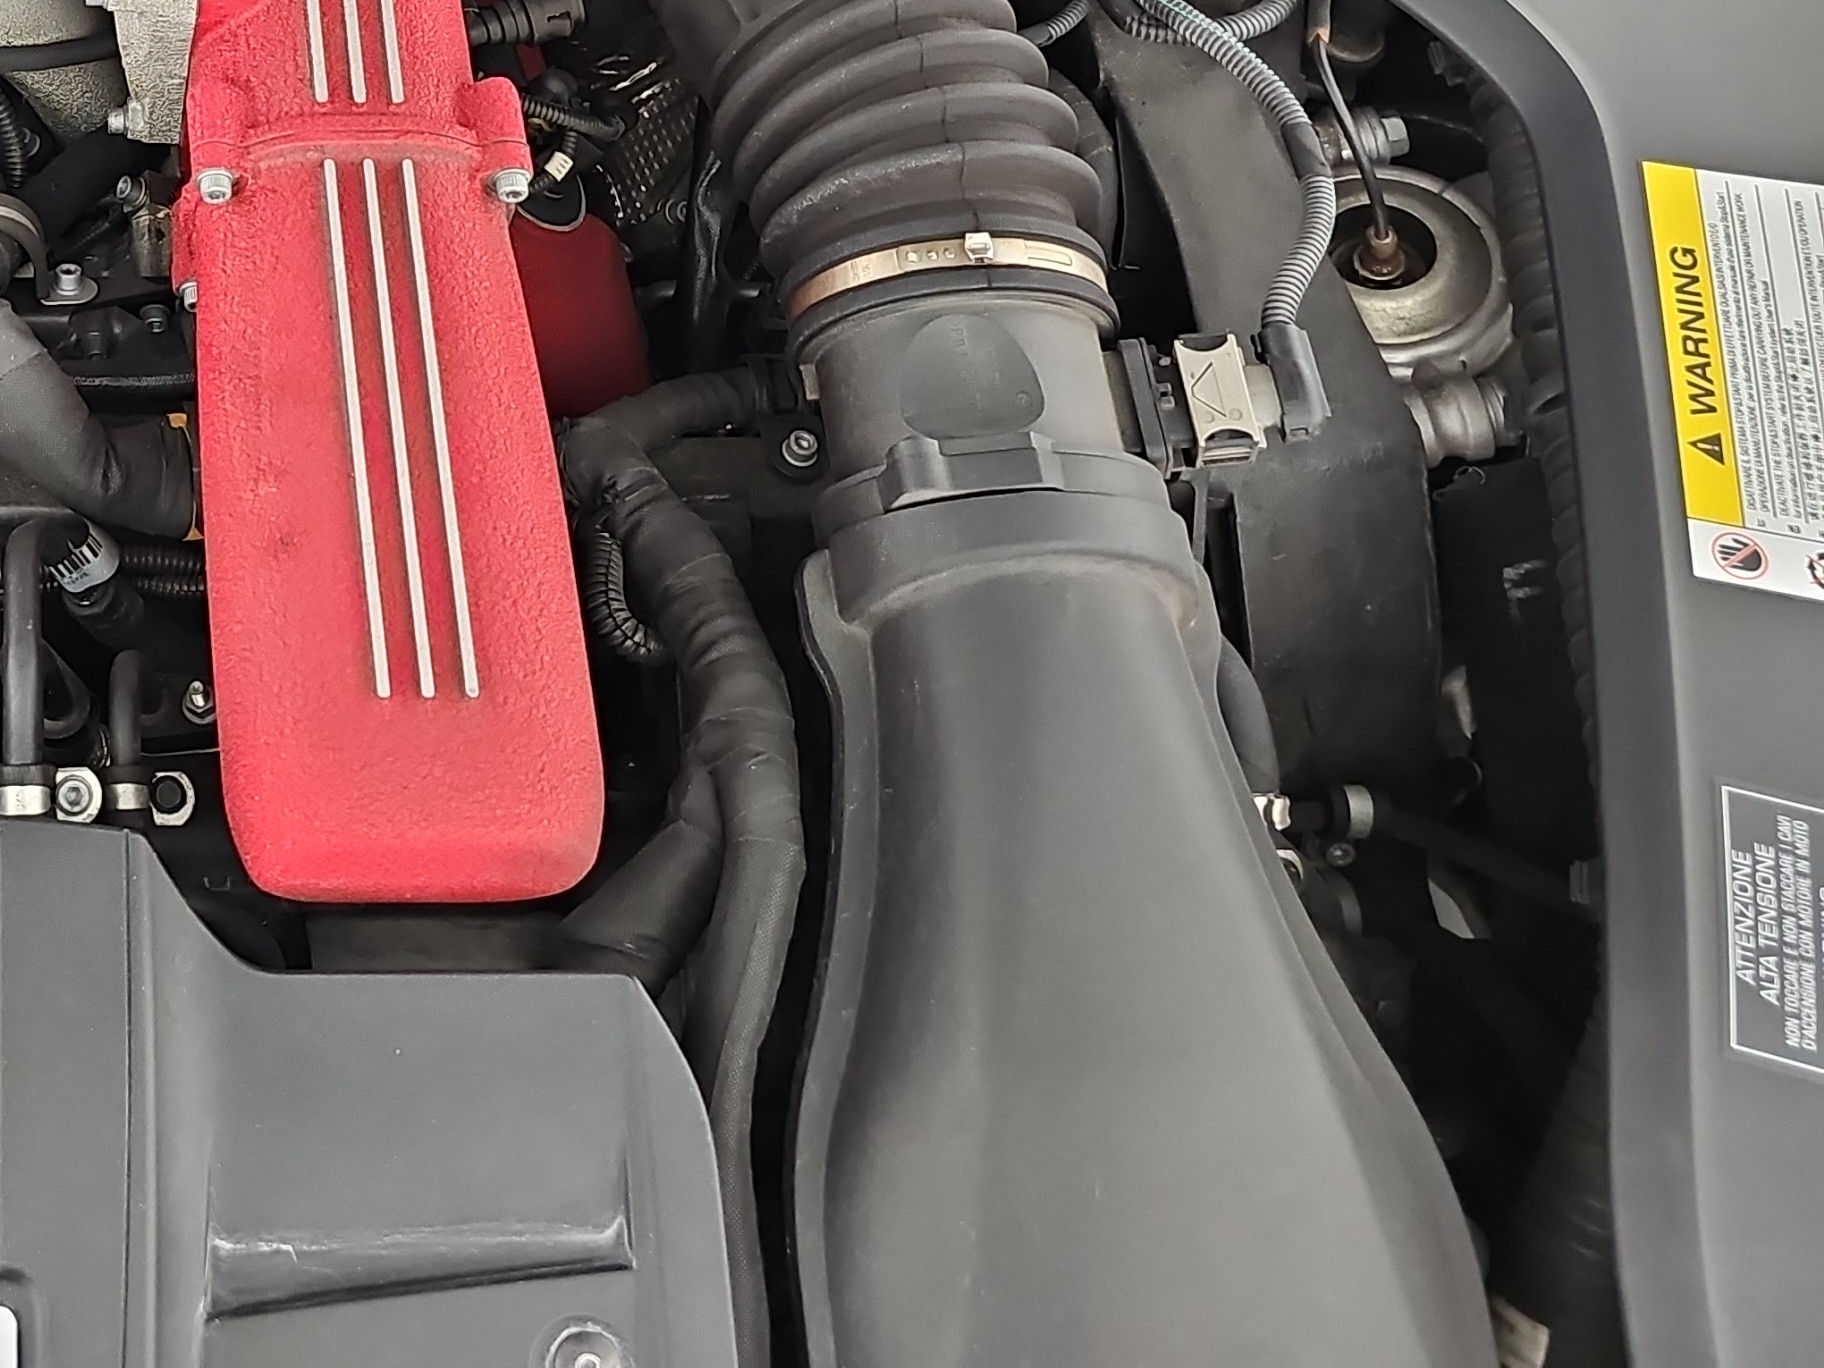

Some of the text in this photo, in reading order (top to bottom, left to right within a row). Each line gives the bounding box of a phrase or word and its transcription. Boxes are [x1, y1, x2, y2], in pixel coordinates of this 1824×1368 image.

[1668, 243, 1718, 419] WARNING
[1777, 814, 1791, 841] CAVI
[1793, 819, 1809, 856] MOTO
[1779, 851, 1794, 912] STACCARE
[1795, 858, 1810, 873] IN
[1731, 848, 1756, 985] ATTENZIONE
[1754, 841, 1780, 1005] ALTA TENSIONE
[1796, 874, 1813, 927] MOTORE
[1781, 914, 1796, 943] NON
[1798, 929, 1814, 957] CON
[1782, 956, 1799, 1014] TOCCARE
[1798, 959, 1818, 1051] D'ACCENSIONE
[1784, 1016, 1800, 1047] NON
